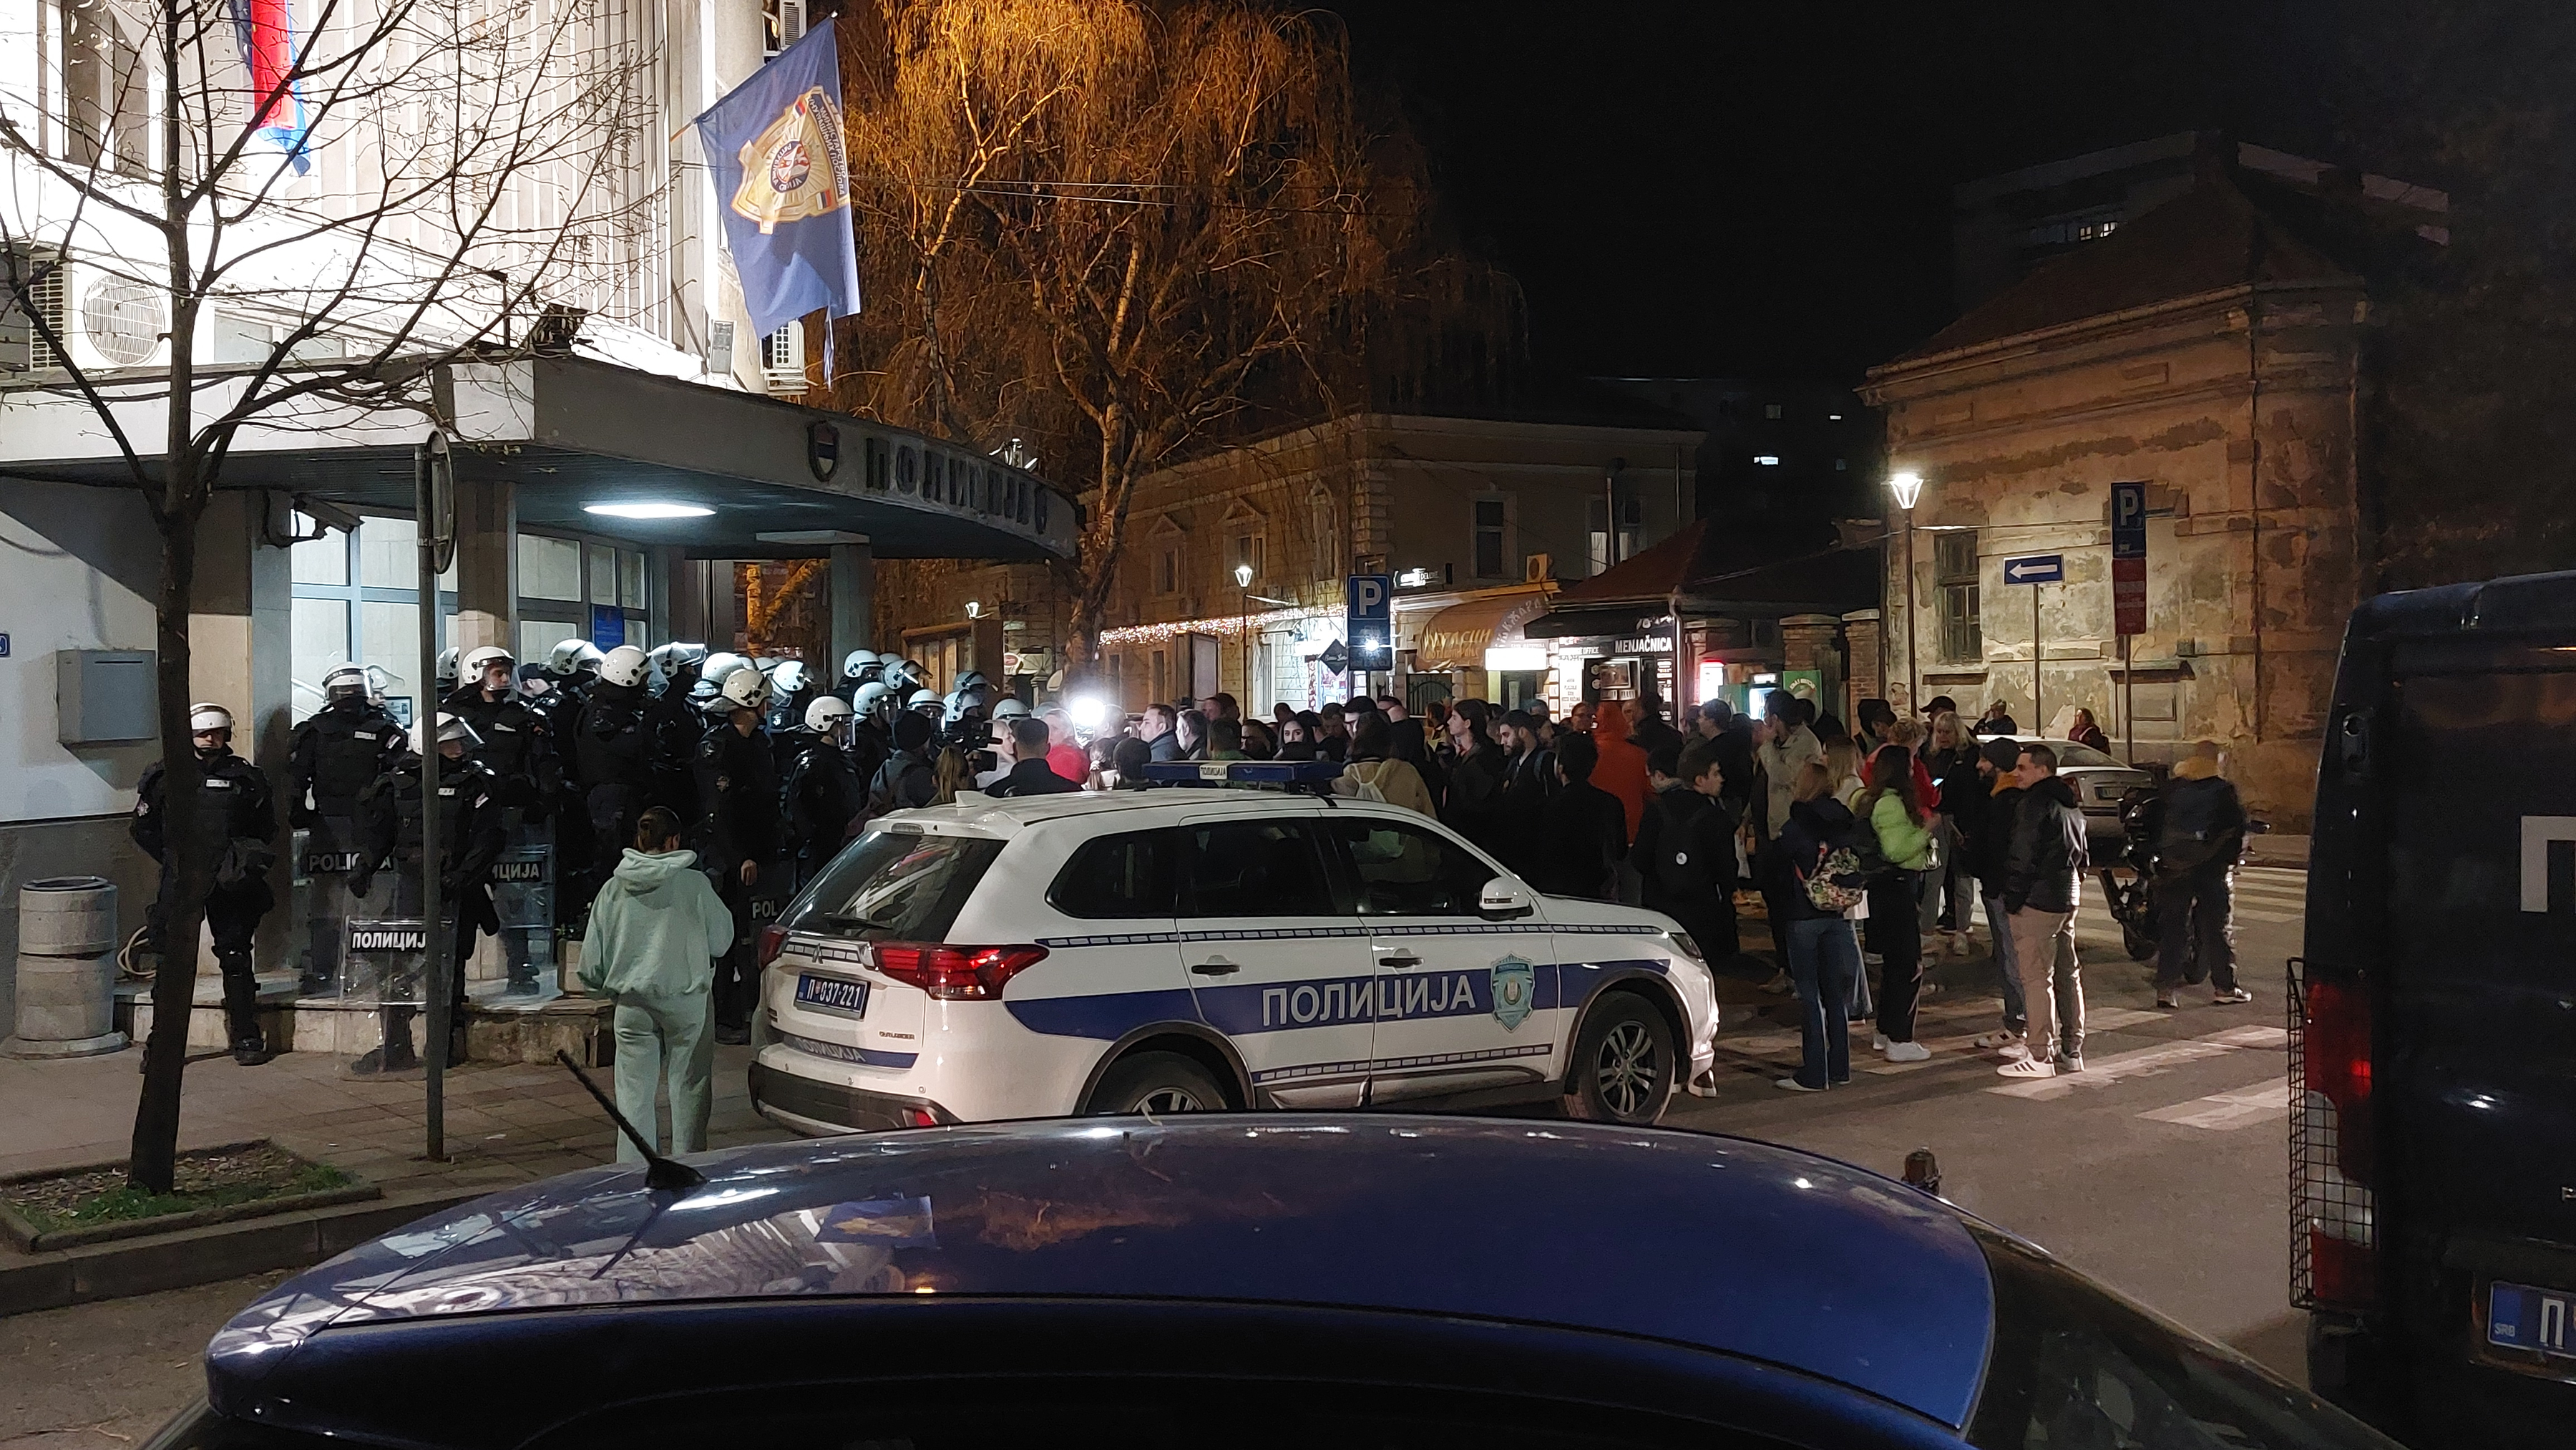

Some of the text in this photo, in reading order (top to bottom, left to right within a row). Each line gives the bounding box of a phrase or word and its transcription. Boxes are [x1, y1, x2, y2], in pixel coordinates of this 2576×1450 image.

[830, 152, 844, 195] ПОСЛОВА
[2119, 489, 2138, 526] P
[1358, 580, 1382, 615] P
[1614, 635, 1673, 653] MENJAČNICA
[1262, 974, 1476, 1027] ПОЛИЦИЈА
[2494, 1323, 2516, 1338] SRB
